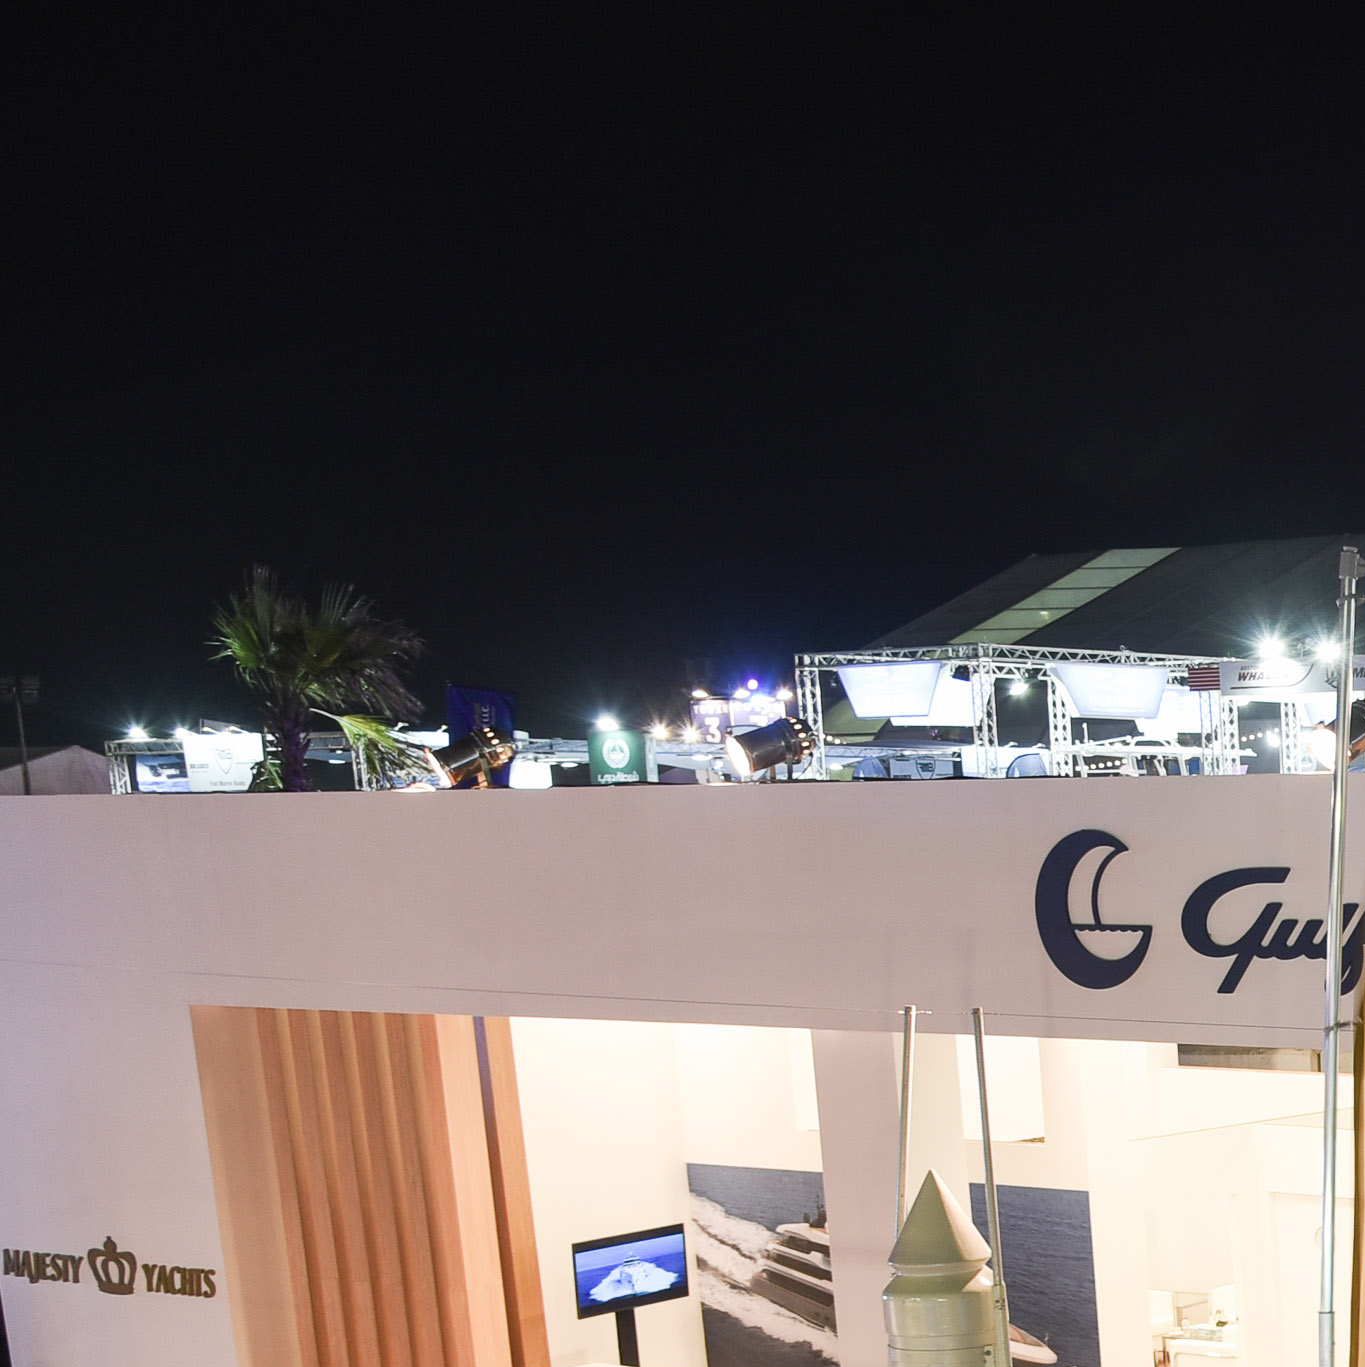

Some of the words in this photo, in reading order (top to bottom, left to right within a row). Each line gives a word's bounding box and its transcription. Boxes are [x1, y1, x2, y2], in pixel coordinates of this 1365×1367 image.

[704, 716, 722, 744] 3
[3, 1248, 84, 1284] MAJESTY
[141, 1263, 217, 1298] YACHTS
